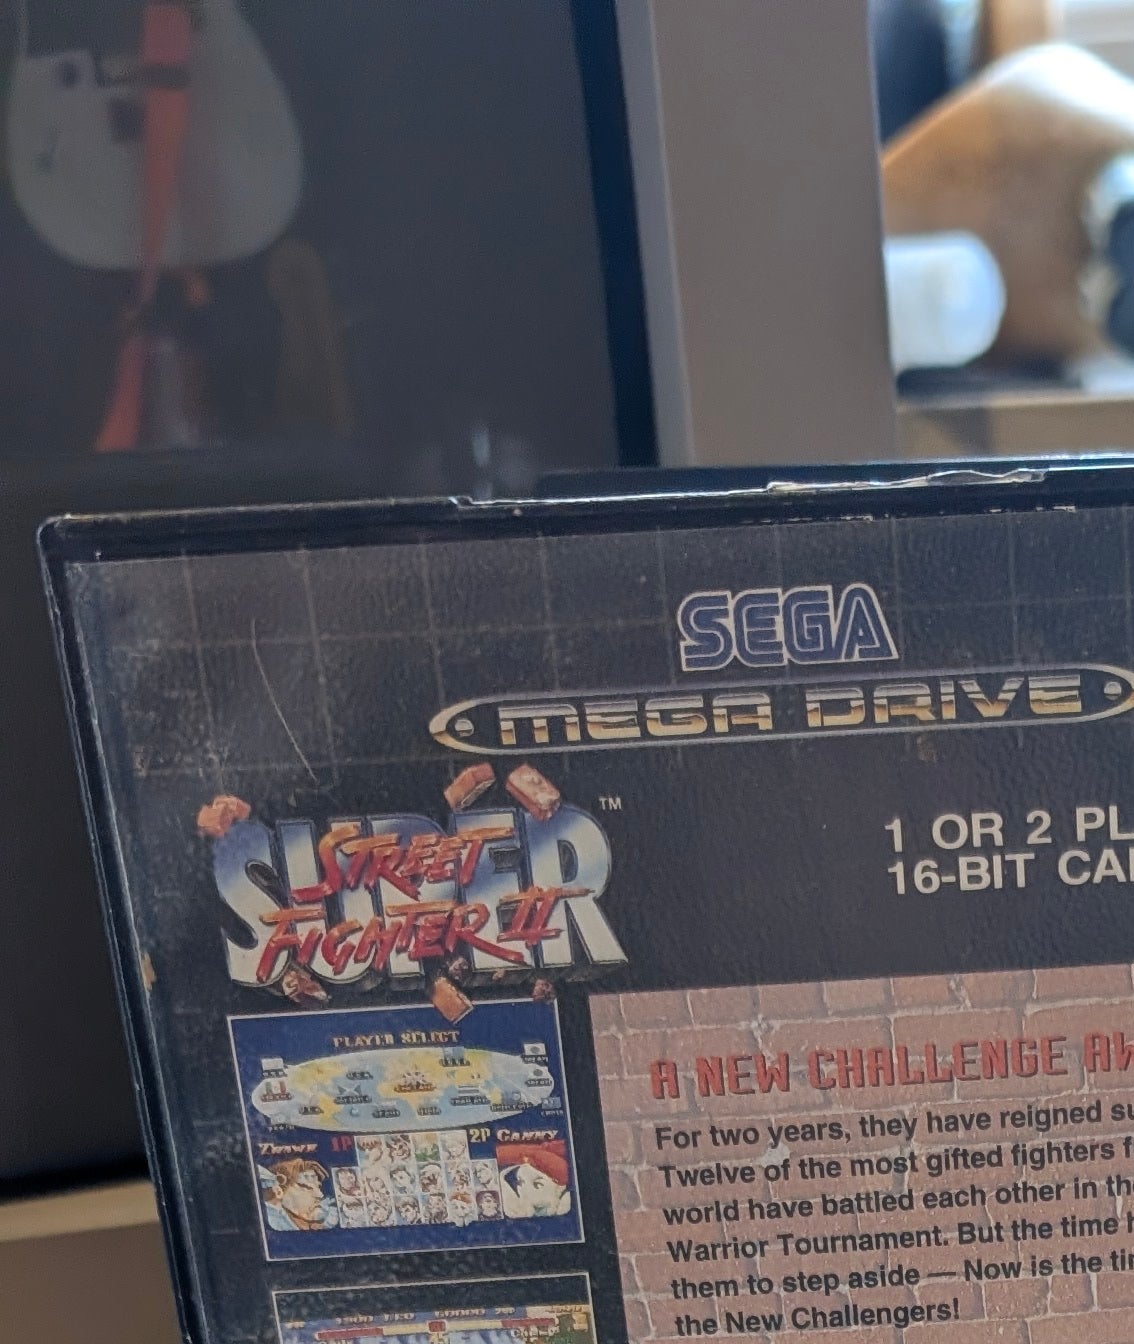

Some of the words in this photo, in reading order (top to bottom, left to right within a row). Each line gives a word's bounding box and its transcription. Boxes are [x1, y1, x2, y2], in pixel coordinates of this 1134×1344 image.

[676, 583, 899, 672] SEGA
[499, 693, 774, 746] MEGA
[804, 673, 1084, 728] DRIVE
[886, 816, 903, 853] 1
[931, 811, 1003, 849] OR
[1026, 809, 1051, 844] 2
[291, 822, 516, 901] STREET
[887, 852, 1034, 895] 16-BIT
[255, 898, 527, 984] FIGHTER
[650, 1058, 681, 1099] A
[695, 1050, 790, 1098] NEW
[807, 1034, 1067, 1092] CHALLENGE
[654, 1126, 701, 1150] For
[709, 1124, 759, 1146] two
[766, 1121, 850, 1149] years,
[858, 1114, 917, 1141] they
[926, 1110, 991, 1133] have
[999, 1098, 1101, 1132] reigned
[657, 1162, 755, 1187] Twelve
[764, 1158, 794, 1182] of
[797, 1157, 841, 1179] the
[849, 1151, 918, 1177] most
[925, 1144, 1003, 1177] gifted
[1010, 1139, 1114, 1170] fighters
[674, 1314, 718, 1336] the
[725, 1311, 783, 1333] New
[791, 1297, 959, 1329] Challengers!
